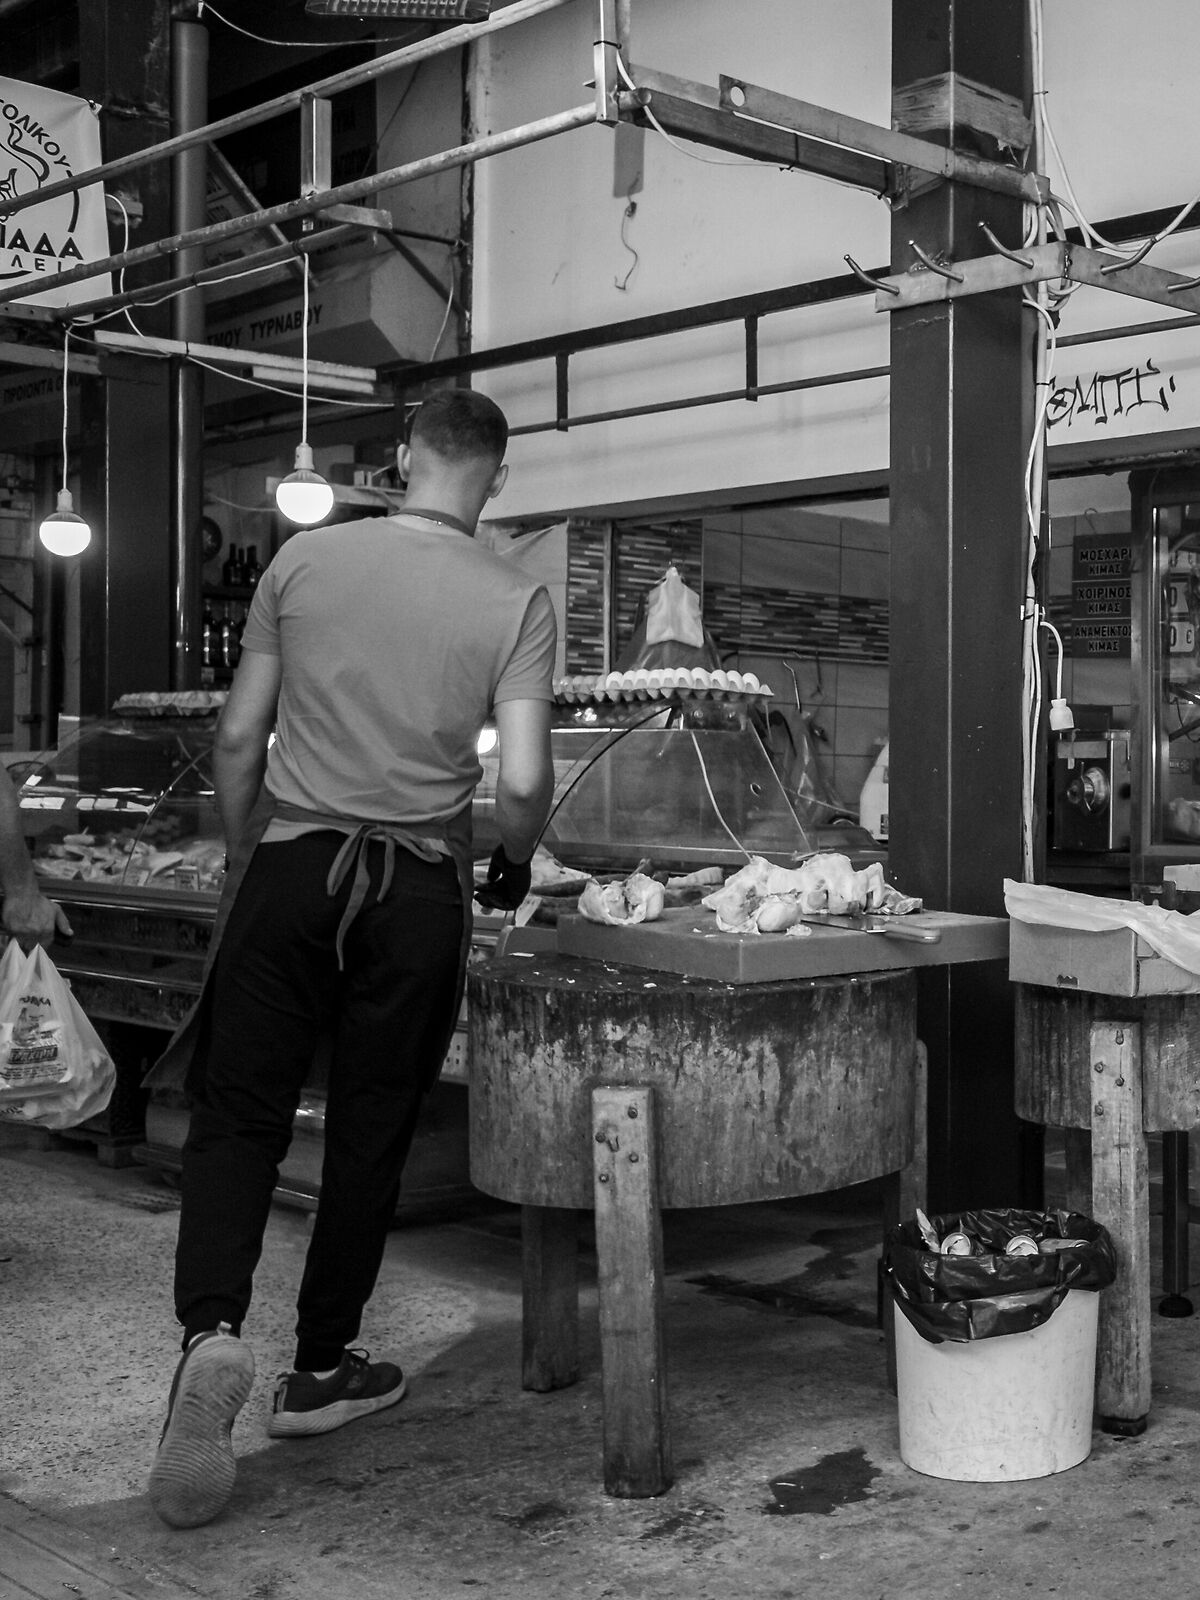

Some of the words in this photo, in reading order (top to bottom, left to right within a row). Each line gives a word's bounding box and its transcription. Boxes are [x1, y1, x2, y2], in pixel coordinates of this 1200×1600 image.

[0, 98, 71, 167] ΟΛΙΚΟΥ
[0, 223, 84, 261] ΑΔΑ
[11, 254, 62, 273] ΛΕΙ
[1088, 564, 1120, 576] ΚΙΜΑΣ
[1079, 586, 1131, 600] ΧΟΙΡΙΝΟΣ
[1088, 602, 1120, 614] ΚΙΜΑΣ
[1088, 641, 1119, 652] ΚΙΜΑΣ
